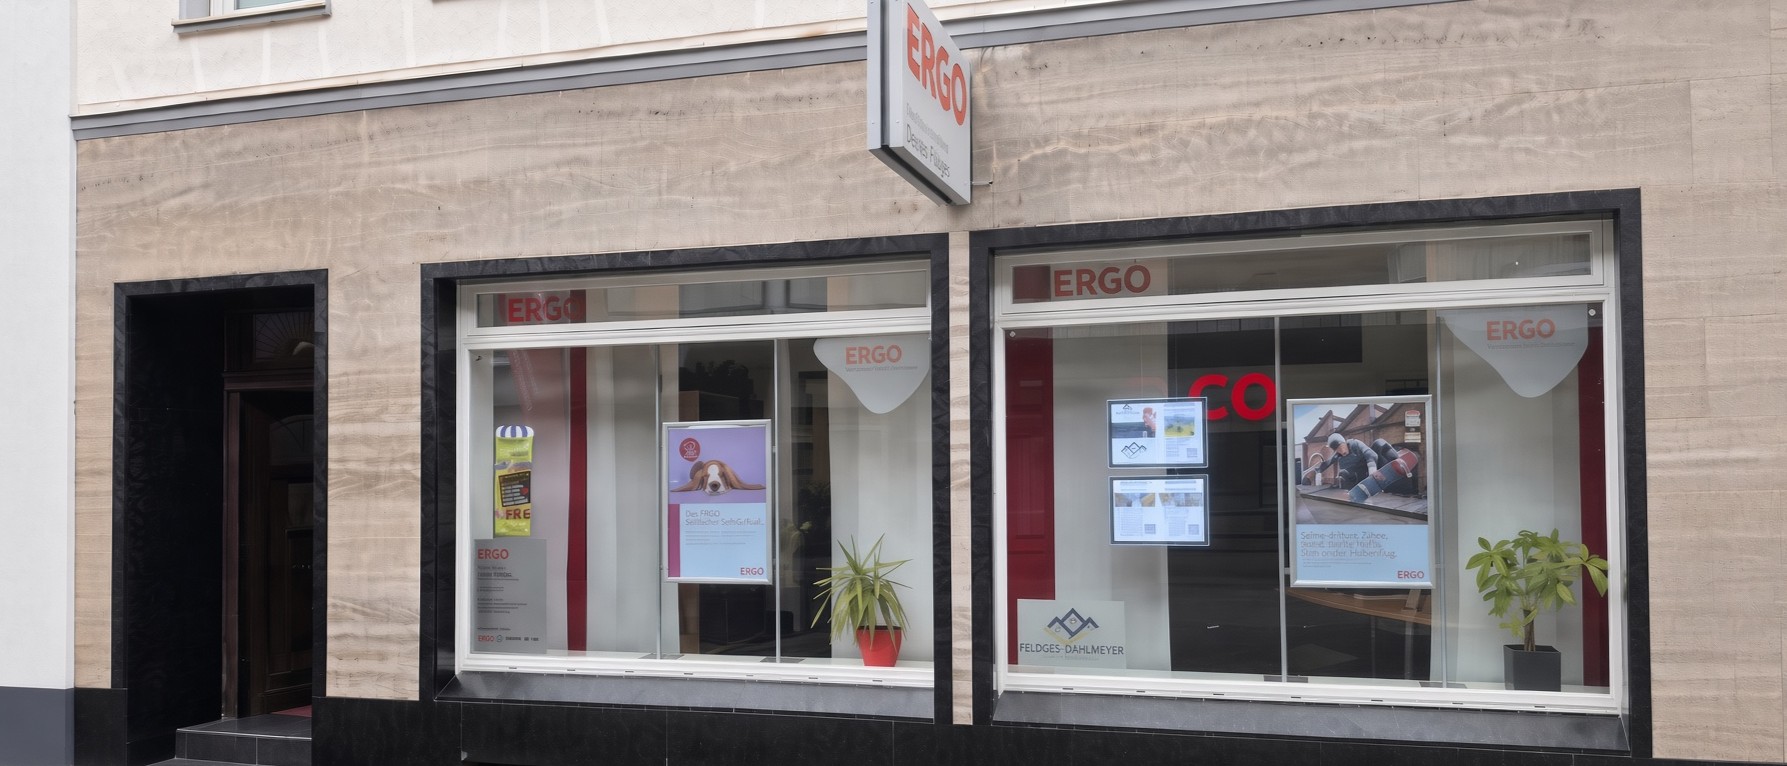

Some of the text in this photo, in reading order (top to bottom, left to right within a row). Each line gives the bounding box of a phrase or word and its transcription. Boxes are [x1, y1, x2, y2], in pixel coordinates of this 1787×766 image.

[907, 2, 967, 126] ERGO
[1054, 264, 1151, 297] ERGO
[508, 295, 582, 323] ERGO
[1486, 318, 1556, 341] ERGO
[845, 344, 902, 365] ERGO
[477, 548, 509, 560] ERGO
[740, 567, 764, 576] ERGO
[1397, 570, 1424, 579] ERGO
